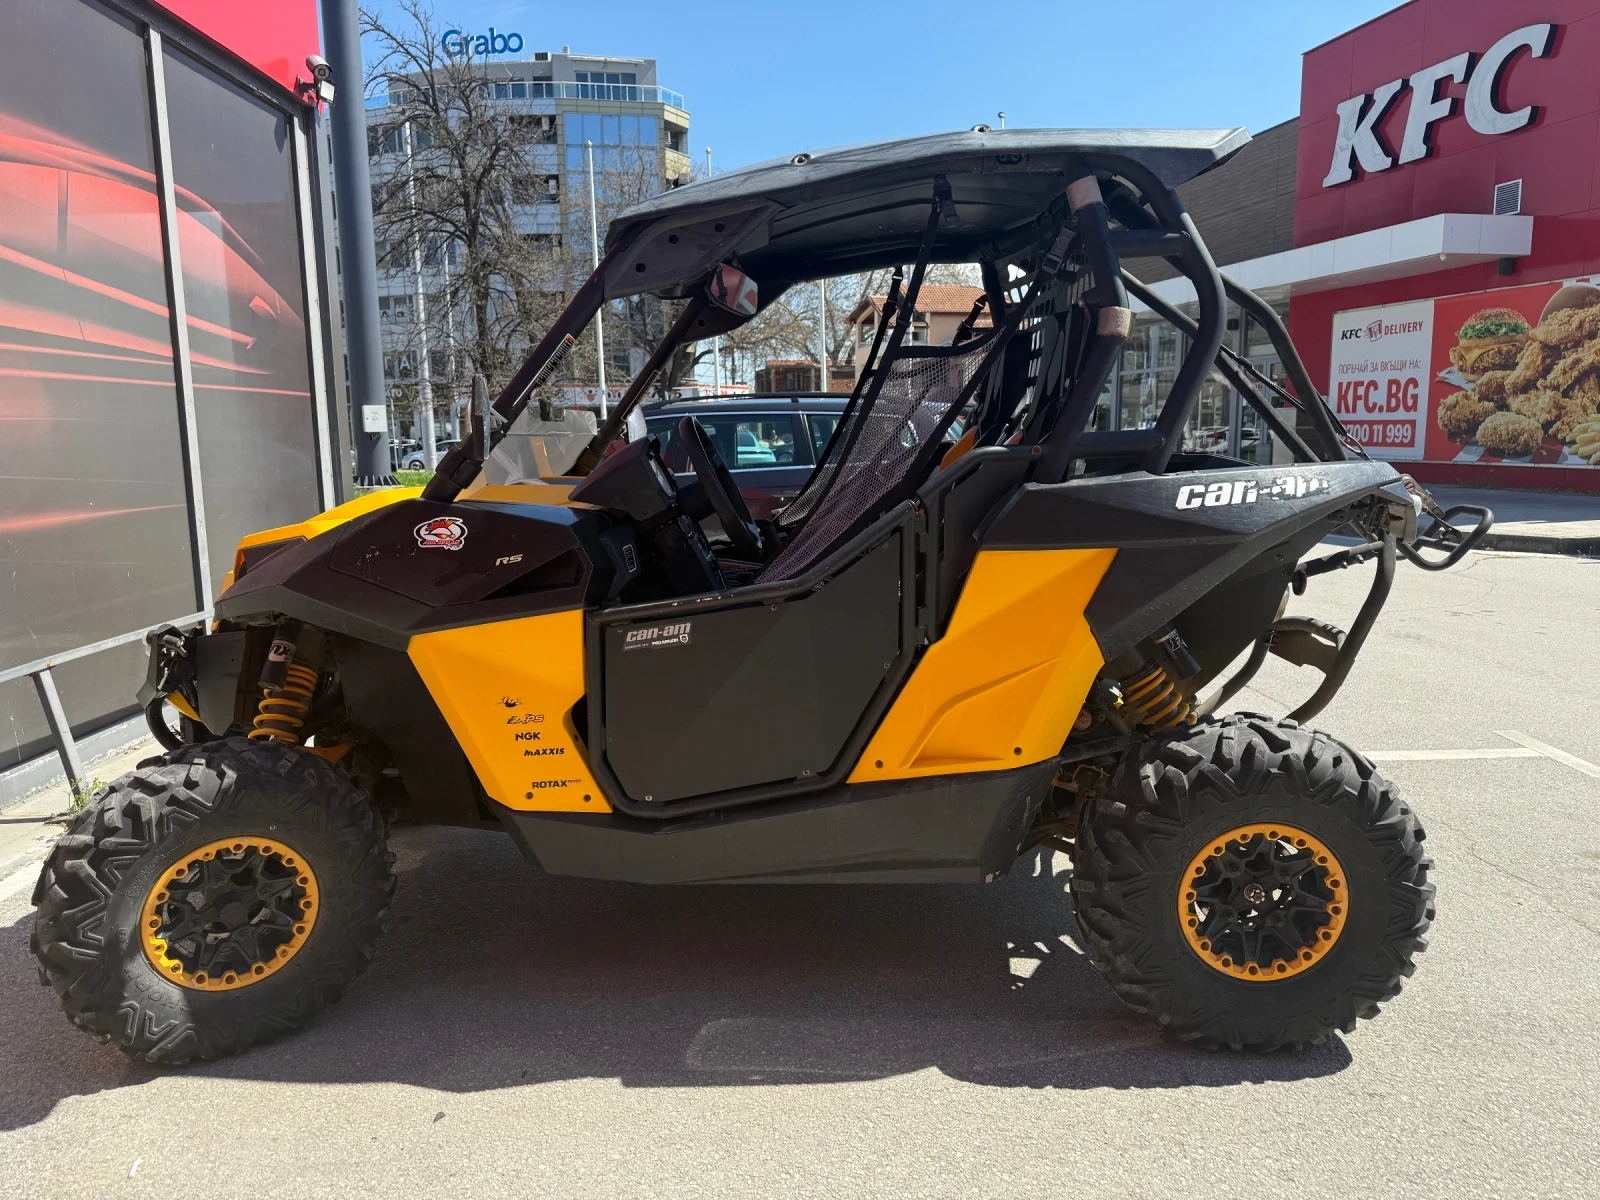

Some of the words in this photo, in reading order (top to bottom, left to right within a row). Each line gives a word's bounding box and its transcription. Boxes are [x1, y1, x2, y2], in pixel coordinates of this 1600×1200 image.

[442, 27, 523, 56] Grabo
[1322, 24, 1555, 187] KFC
[1340, 328, 1362, 340] KFC
[1384, 320, 1424, 335] DELIVERY
[1338, 359, 1369, 375] ПОРЪЧАЙ
[1370, 362, 1379, 373] ЗА
[1380, 359, 1407, 373] ВКЪЩИ
[1409, 358, 1421, 370] НА:
[1336, 377, 1419, 414] KFC.BG
[1372, 424, 1383, 443] 11
[1386, 424, 1411, 443] 999
[495, 554, 524, 566] RS
[626, 622, 691, 642] can-am
[515, 731, 541, 741] NGK
[531, 779, 568, 789] ROTAX
